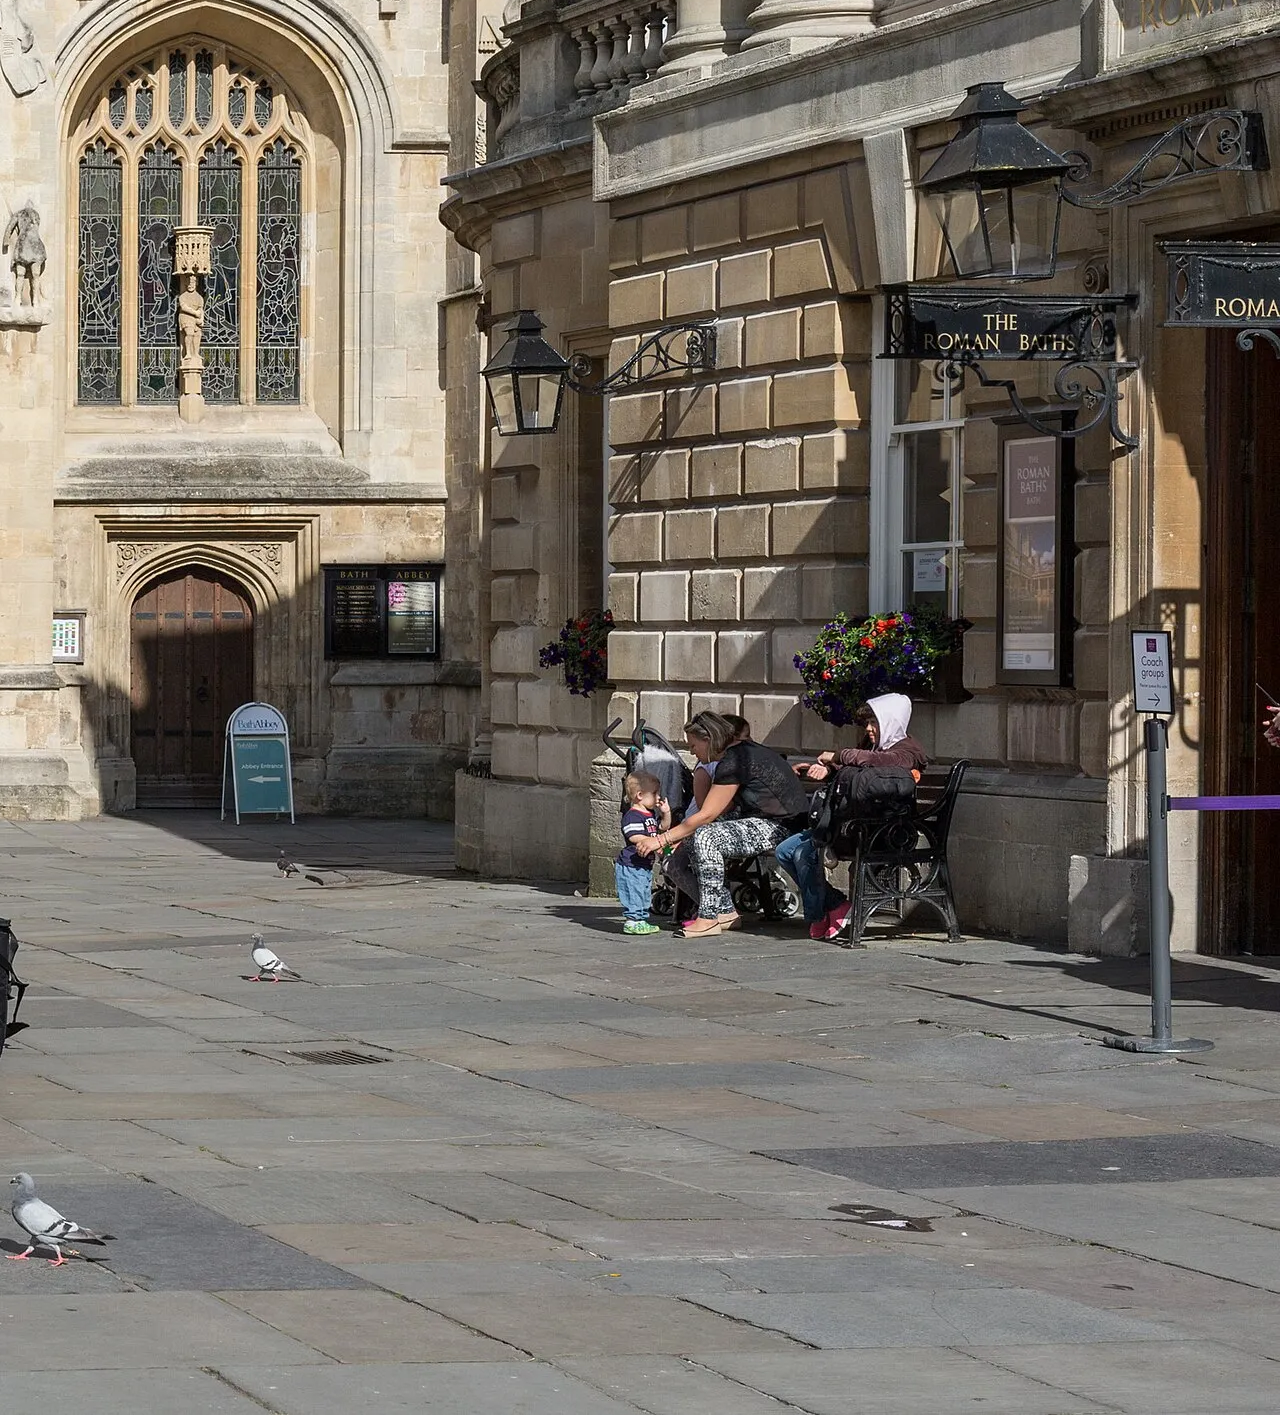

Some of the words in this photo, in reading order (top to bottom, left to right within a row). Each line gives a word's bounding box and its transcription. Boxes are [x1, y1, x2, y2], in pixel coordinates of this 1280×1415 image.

[982, 313, 1018, 331] THE
[924, 332, 1000, 351] ROMAN
[1019, 333, 1076, 351] BATHS
[1028, 455, 1039, 464] THE
[1017, 465, 1051, 481] ROMAN
[1020, 479, 1047, 494] BATHS
[1026, 496, 1041, 505] BATH
[340, 571, 368, 579] BATH
[396, 571, 432, 579] ABBEY
[1141, 655, 1164, 667] Coach
[1141, 669, 1165, 680] groups
